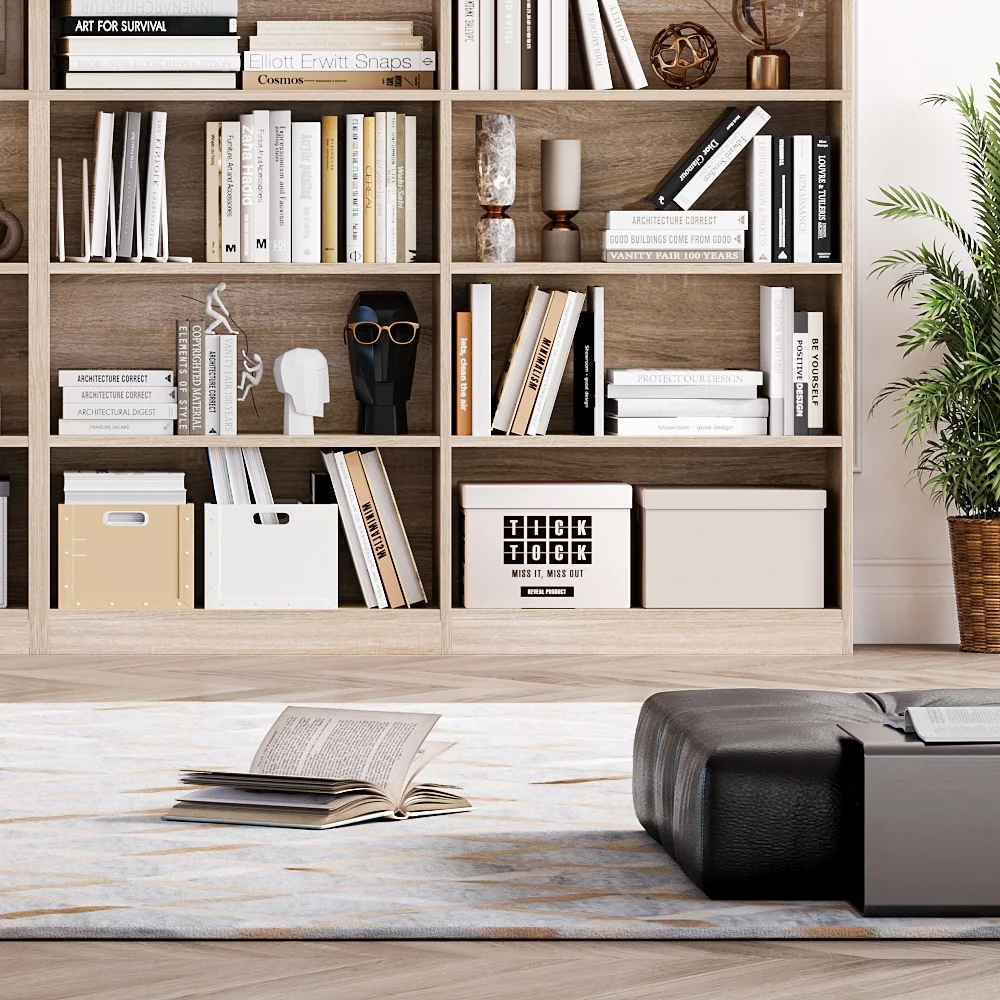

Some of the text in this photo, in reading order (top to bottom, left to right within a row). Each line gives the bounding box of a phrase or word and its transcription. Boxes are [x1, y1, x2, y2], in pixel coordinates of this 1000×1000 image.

[82, 0, 214, 15] INNENARCHITEKTUR
[75, 20, 167, 32] ART FOR SURVIVAL
[250, 53, 412, 71] Elliott Erwitt Snaps
[257, 74, 304, 85] Cosmos
[242, 124, 254, 206] Zaha Hadid
[679, 138, 720, 182] Dior Glamour
[632, 216, 717, 225] ARCHITECTURE CORRECT
[256, 238, 267, 249] M
[609, 235, 731, 244] GOOD BUILDINGS COME FROM GOOD
[225, 244, 236, 252] M
[610, 251, 739, 260] VANITY FAIR 100 YEARS
[460, 357, 468, 382] clean
[528, 337, 552, 391] MINIMALISM
[77, 374, 148, 383] ARCHITECTURE CORRECT
[179, 325, 188, 430] ELEMENTS OF STYLE
[192, 325, 202, 431] COPYRIGHTED MATERIAL
[811, 338, 819, 407] BE YOURSELF
[208, 351, 217, 414] ARCHITECTURE CORRECT
[460, 383, 468, 398] the
[460, 398, 468, 412] air
[796, 383, 804, 417] DESIGN
[77, 408, 156, 416] ARCHITECTURAL DIGEST
[509, 519, 587, 536] TICK
[509, 544, 587, 561] TOCK
[512, 569, 584, 579] MISS IT, MISS OUT
